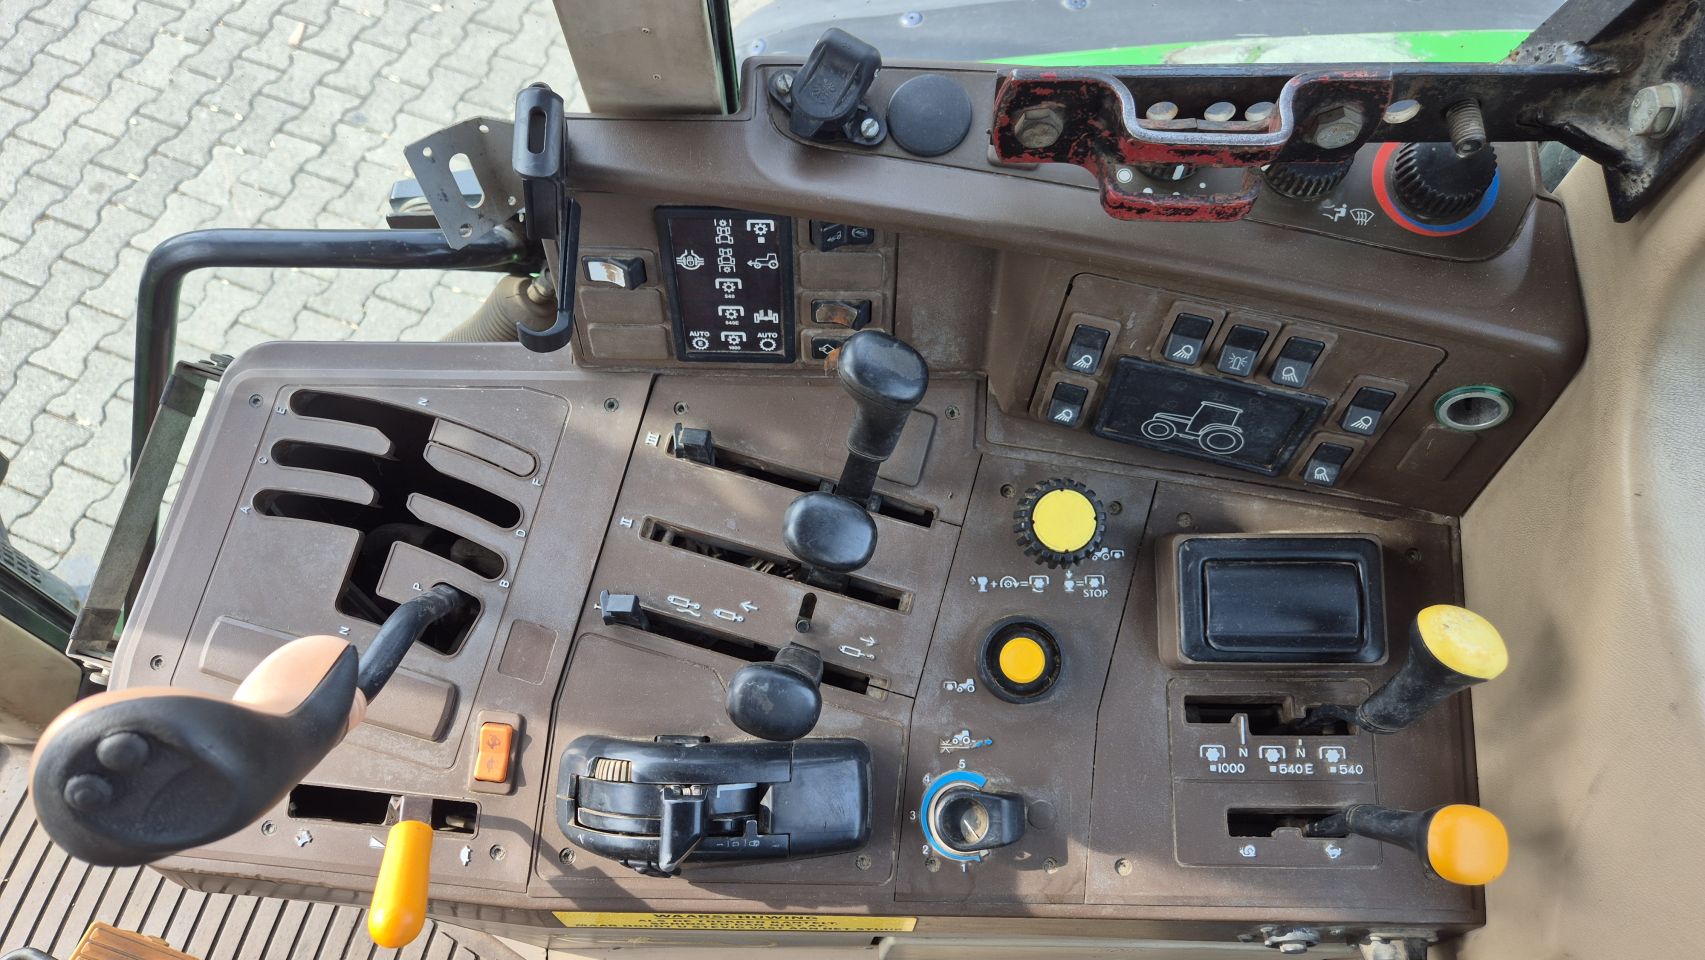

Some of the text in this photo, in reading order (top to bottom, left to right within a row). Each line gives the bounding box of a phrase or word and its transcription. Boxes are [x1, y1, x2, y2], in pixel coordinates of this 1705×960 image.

[276, 407, 287, 415] E
[532, 478, 542, 487] F
[240, 506, 251, 514] A
[516, 529, 526, 538] D
[412, 582, 422, 591] P
[499, 579, 510, 588] B
[1083, 589, 1108, 598] STOP
[1239, 748, 1306, 758] N N
[959, 759, 966, 769] 5
[1218, 763, 1245, 773] 1000
[1339, 764, 1364, 775] 540
[922, 773, 930, 783] 4
[909, 810, 916, 820] 3
[922, 845, 929, 855] 2
[960, 864, 966, 873] 1
